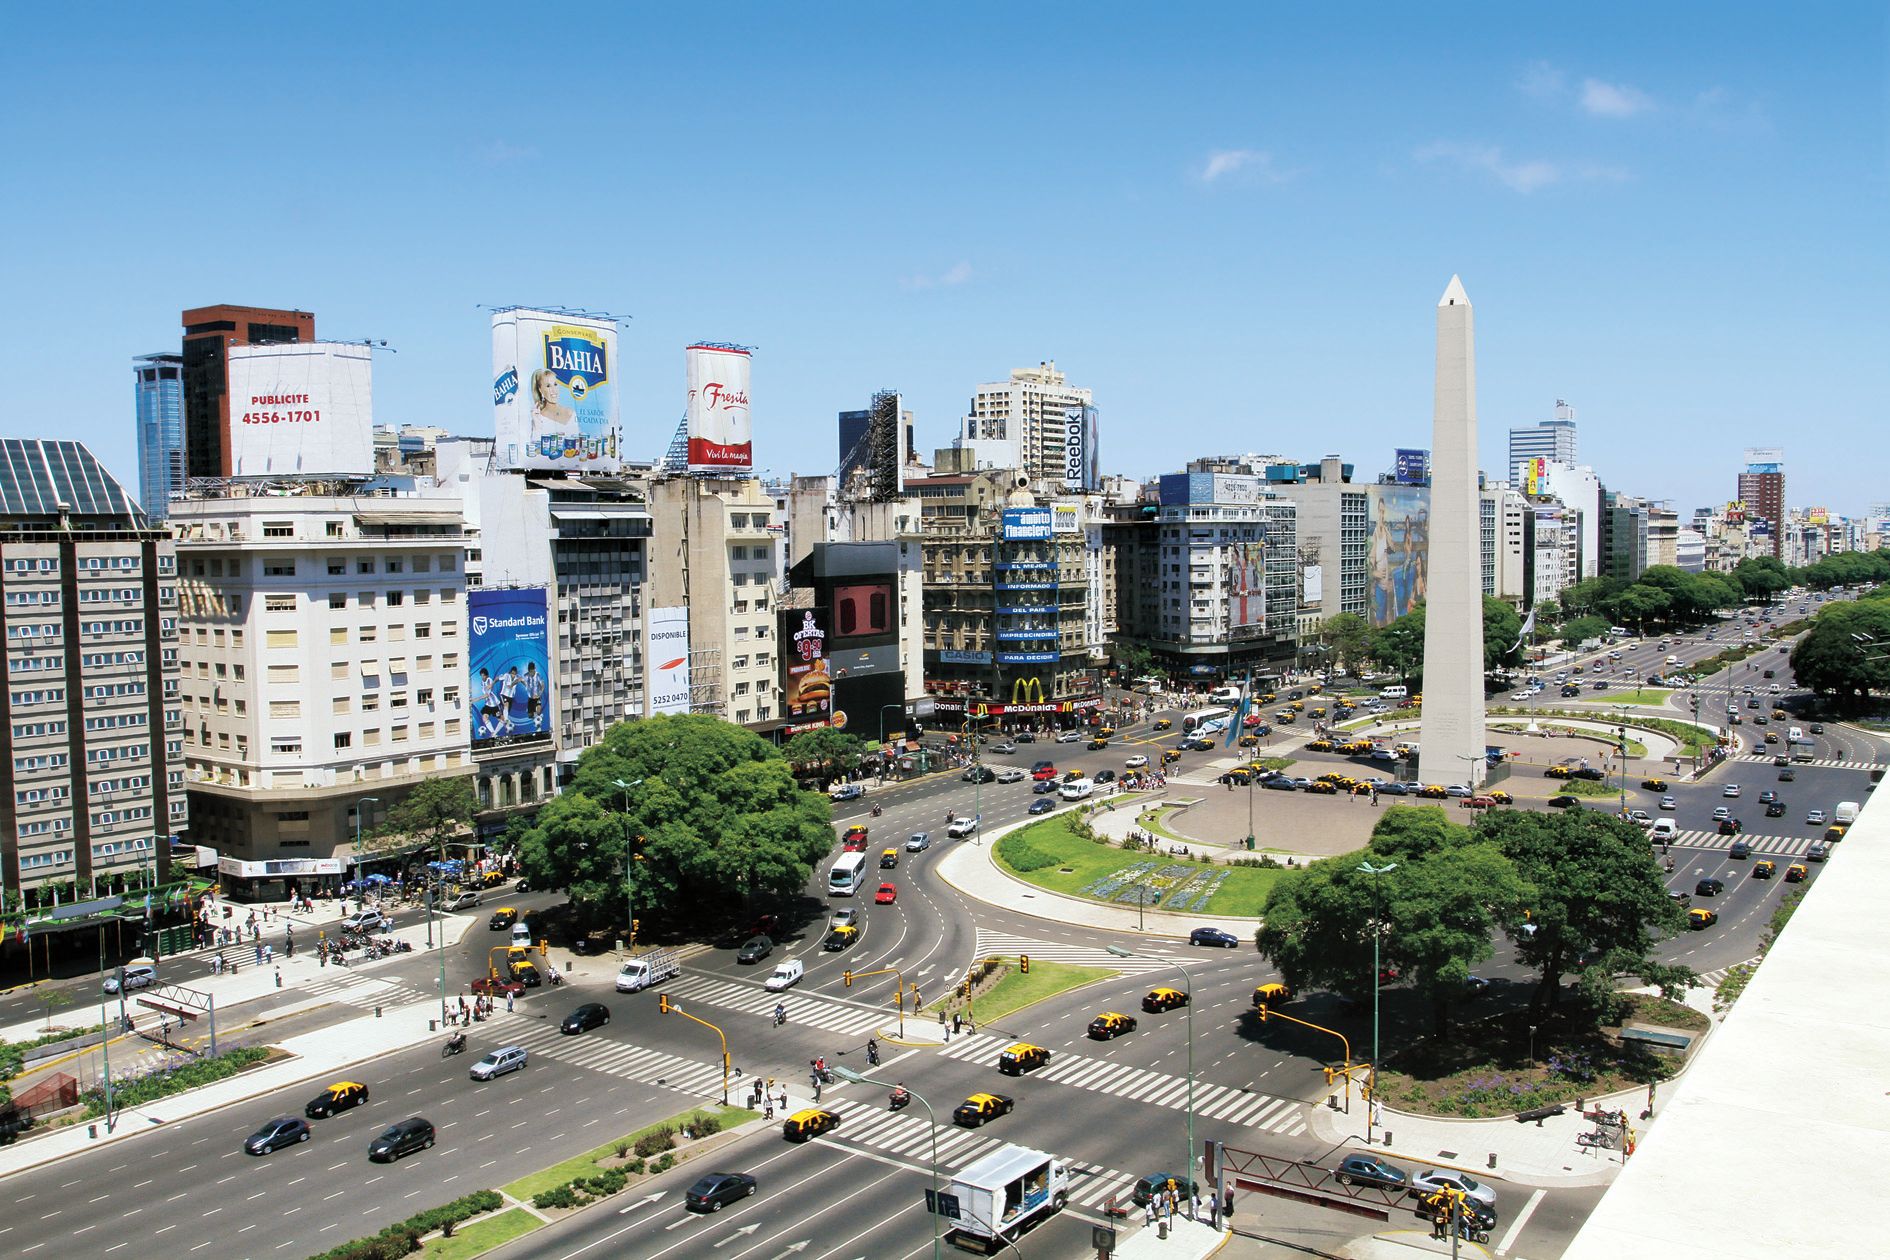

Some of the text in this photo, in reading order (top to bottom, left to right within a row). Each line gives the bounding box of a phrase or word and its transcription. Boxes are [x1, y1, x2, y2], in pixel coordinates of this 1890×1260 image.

[550, 345, 603, 374] BAHIA
[493, 374, 518, 401] BAHIA
[251, 394, 309, 405] PUBLICITE
[702, 383, 749, 411] Fresita
[242, 410, 320, 424] 4556-1701
[1066, 414, 1081, 480] Reebok
[729, 452, 749, 464] magia
[1005, 524, 1051, 538] financiero
[489, 615, 545, 628] Standard Bank
[803, 620, 816, 630] BK
[651, 630, 686, 641] DISPONIBLE
[793, 629, 825, 641] OFERTAS
[945, 652, 984, 660] CASIO
[653, 692, 688, 705] 5252 0470
[1003, 704, 1057, 713] McDonald's
